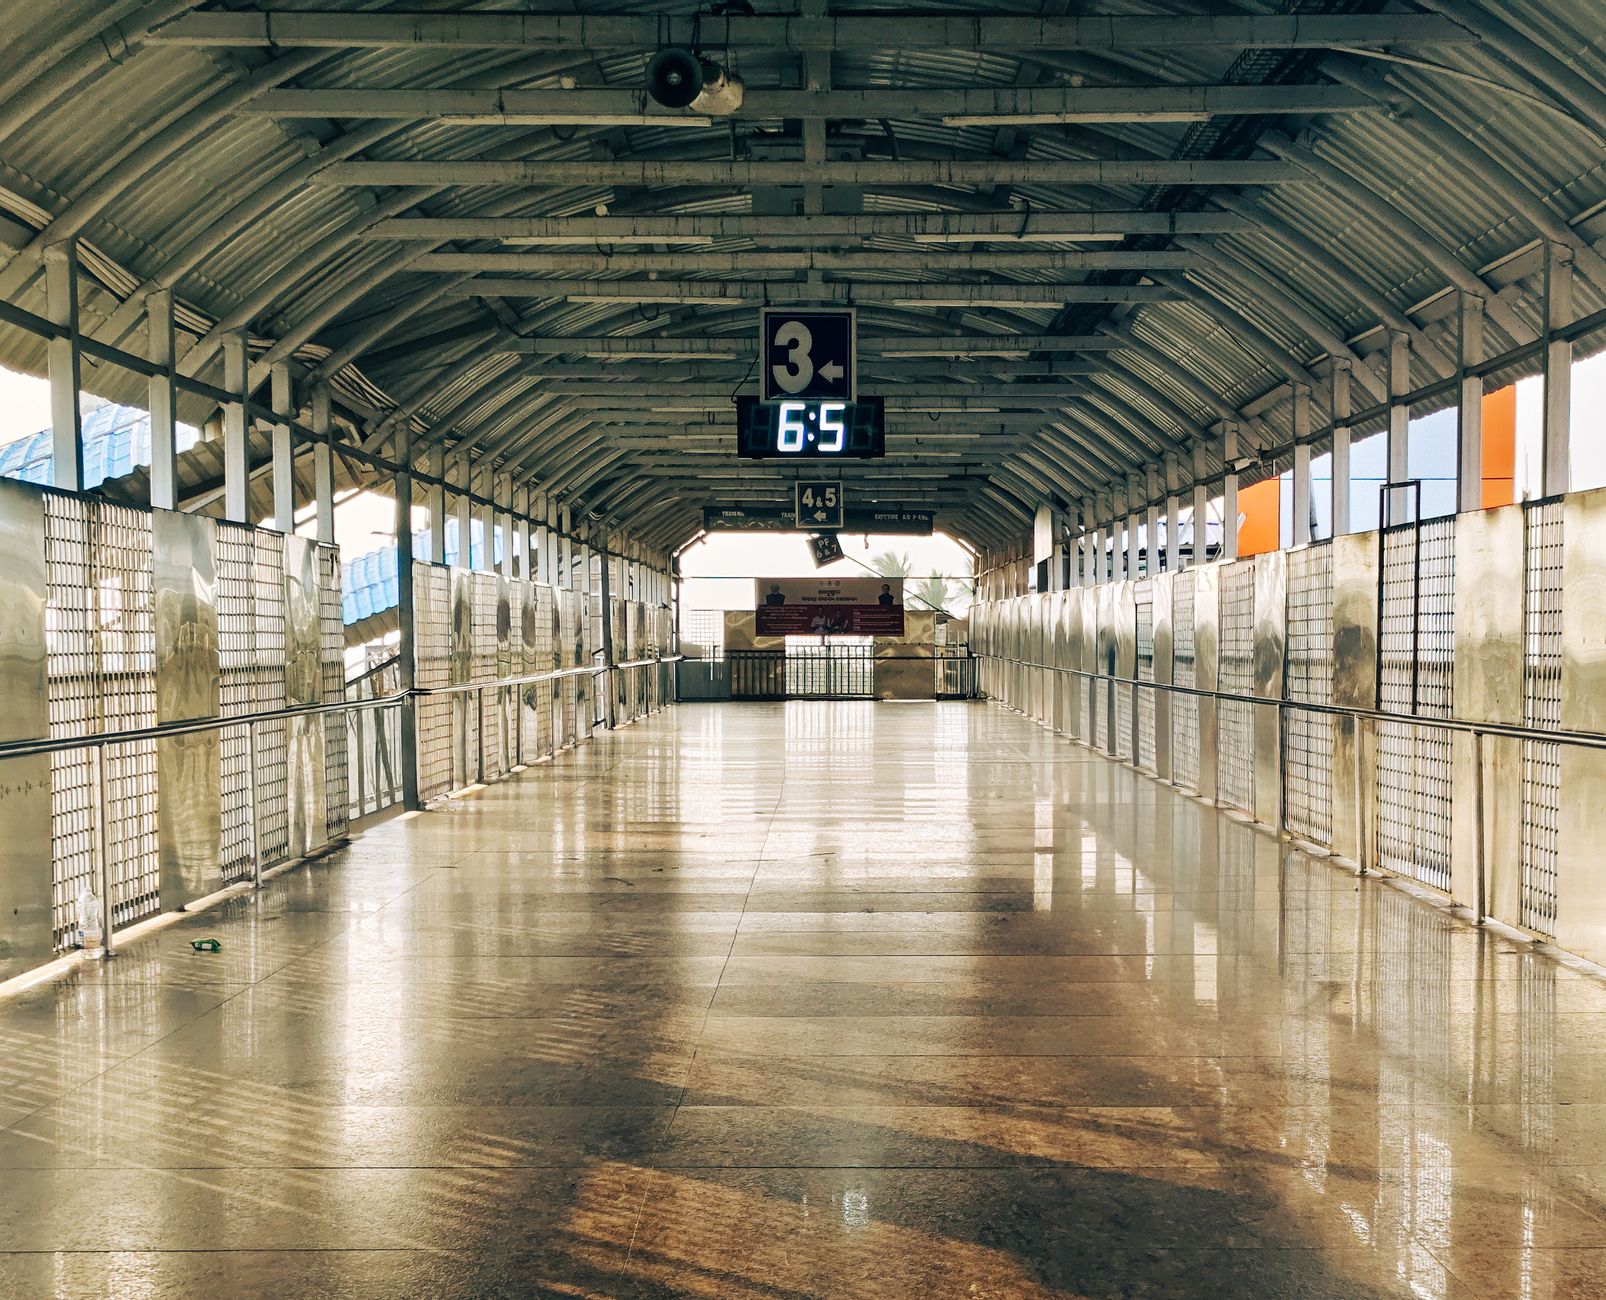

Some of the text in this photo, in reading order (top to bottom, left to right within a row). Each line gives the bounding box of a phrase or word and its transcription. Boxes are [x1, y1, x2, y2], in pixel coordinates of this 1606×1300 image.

[772, 320, 814, 394] 3
[777, 403, 846, 452] 6:5
[802, 487, 837, 508] 4 & 5
[816, 543, 838, 559] 6 & 7
[818, 538, 830, 549] PF
